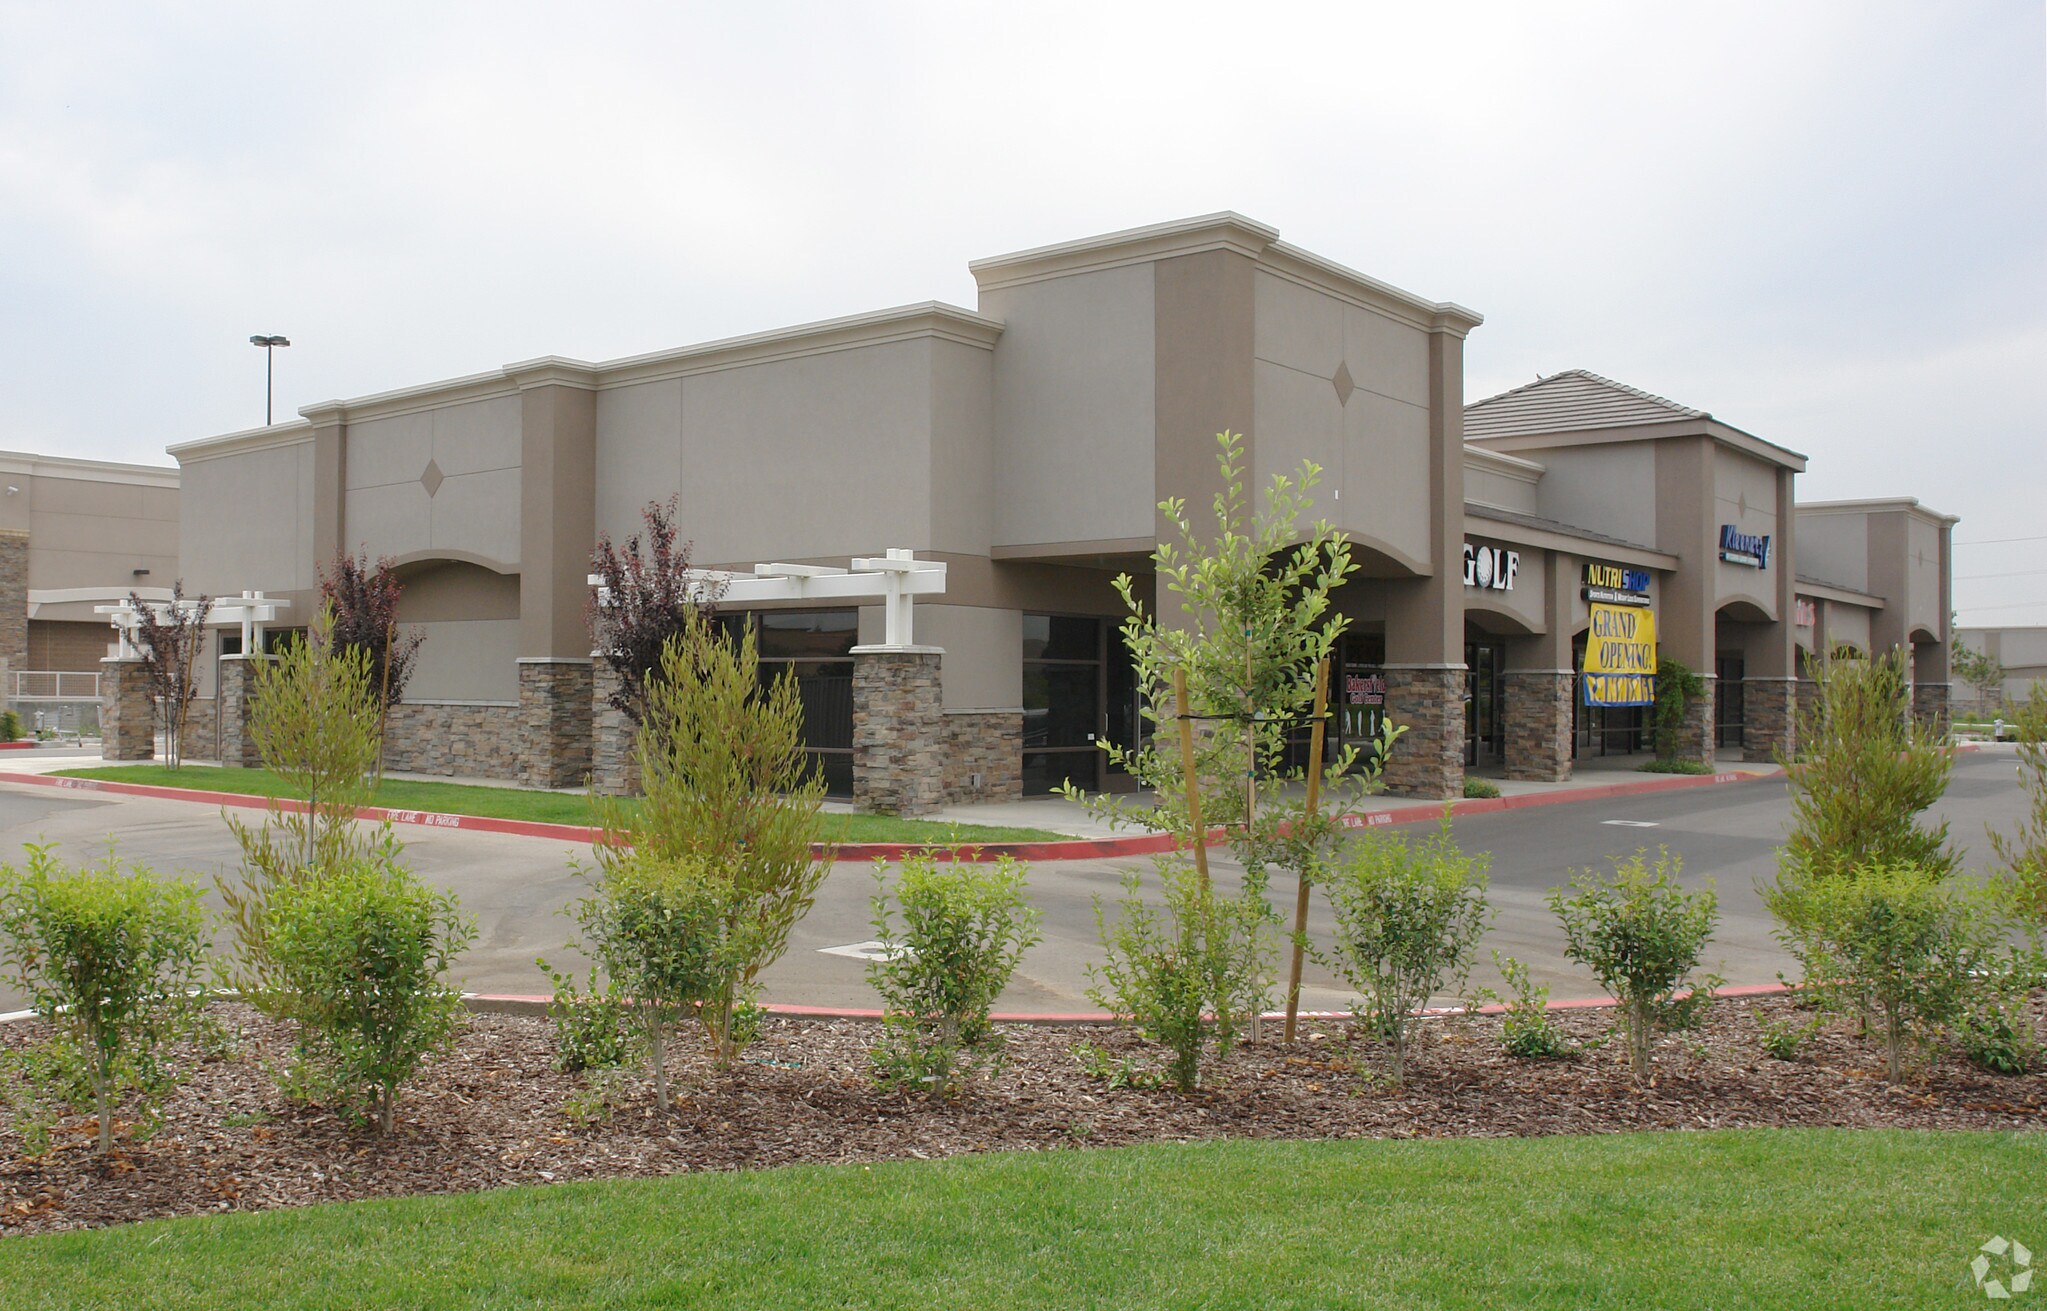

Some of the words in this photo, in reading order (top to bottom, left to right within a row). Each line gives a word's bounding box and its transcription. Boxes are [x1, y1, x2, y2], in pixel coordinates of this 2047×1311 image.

[1463, 543, 1520, 590] GOLF
[1593, 609, 1636, 639] GRAND
[401, 811, 417, 823] LANE
[424, 814, 434, 825] NO
[435, 816, 460, 827] PARKING
